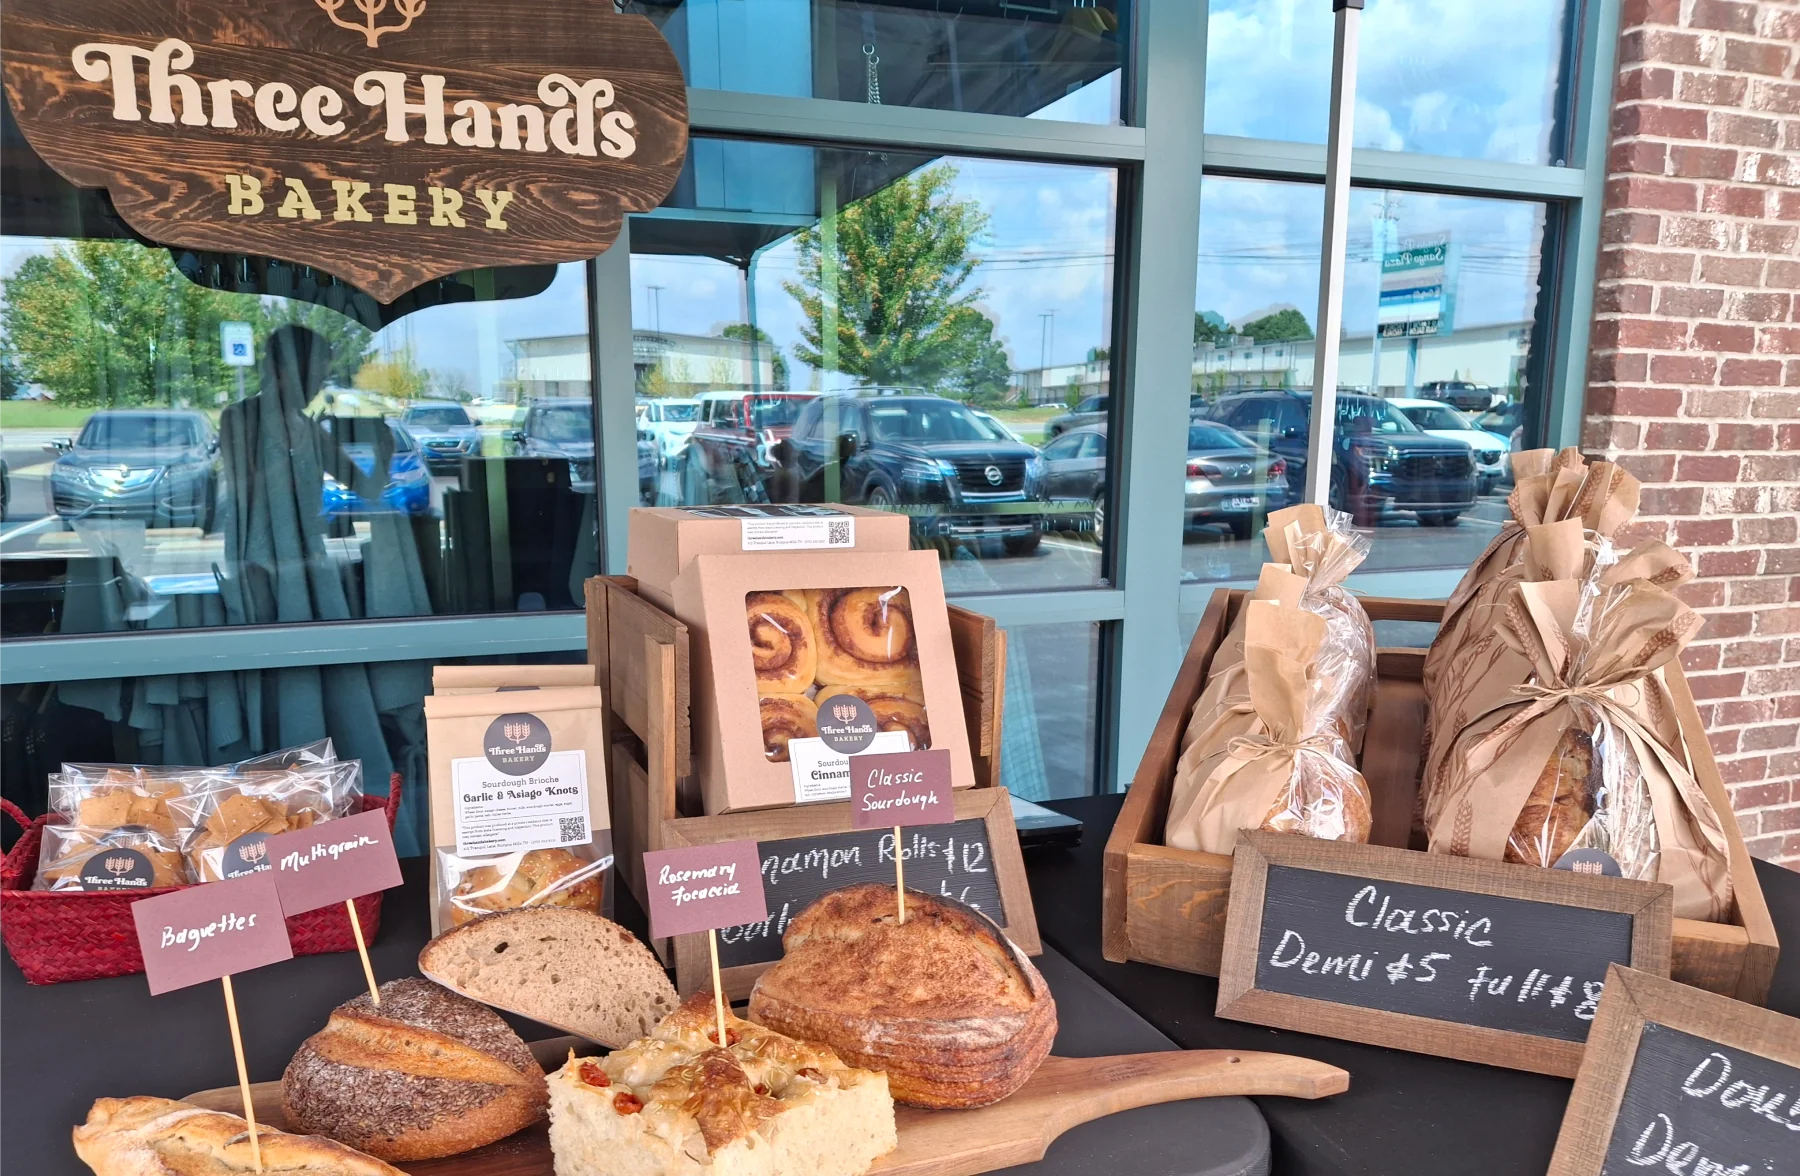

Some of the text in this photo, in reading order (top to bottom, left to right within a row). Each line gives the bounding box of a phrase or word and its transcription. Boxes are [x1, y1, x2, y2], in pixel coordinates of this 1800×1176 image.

[72, 38, 636, 159] Three Hands
[225, 173, 514, 231] BAKERY
[821, 724, 873, 734] Three Hands
[488, 743, 547, 756] Three Hands
[817, 758, 848, 768] Sourdou
[482, 776, 559, 788] Sourdough Brioche
[811, 770, 850, 781] Cinnam
[867, 768, 923, 788] Classic
[463, 792, 493, 804] Garlic
[507, 789, 542, 800] Asiago
[545, 786, 579, 796] Knots
[861, 790, 939, 811] Sourdough
[280, 835, 379, 872] Multigrain
[84, 875, 148, 887] Three Hands
[658, 862, 736, 885] Rosemary
[1345, 885, 1494, 947] Classic
[161, 912, 257, 952] Baguettes
[1269, 929, 1380, 981] Demi
[1385, 952, 1452, 985] $5
